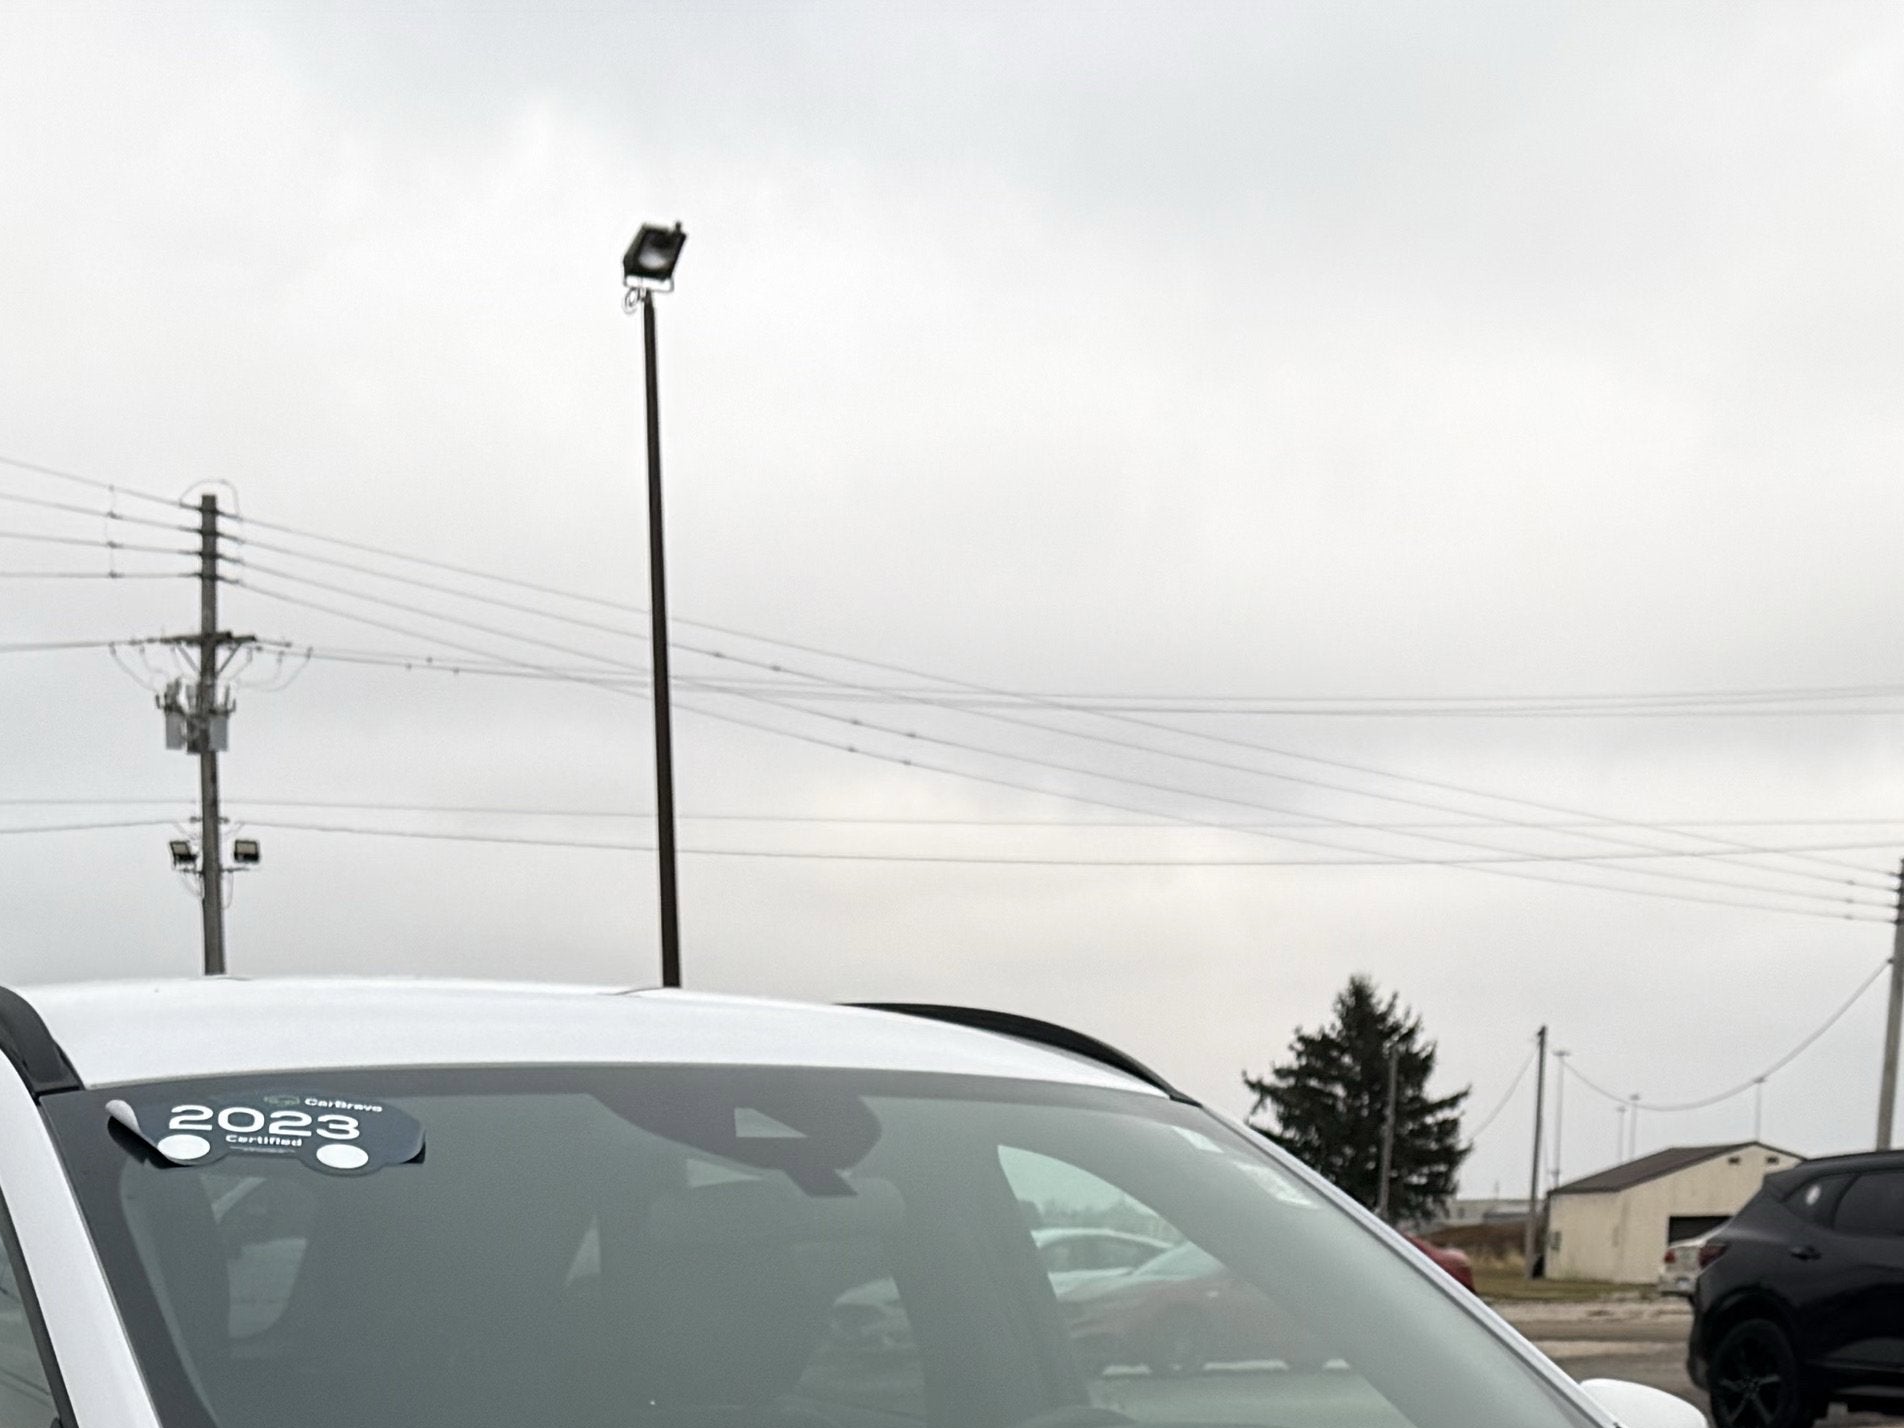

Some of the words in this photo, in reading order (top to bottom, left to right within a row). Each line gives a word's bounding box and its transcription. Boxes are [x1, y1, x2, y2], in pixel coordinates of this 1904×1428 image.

[304, 1097, 383, 1113] CarBravo
[168, 1104, 361, 1141] 2023
[225, 1134, 303, 1147] Certified
